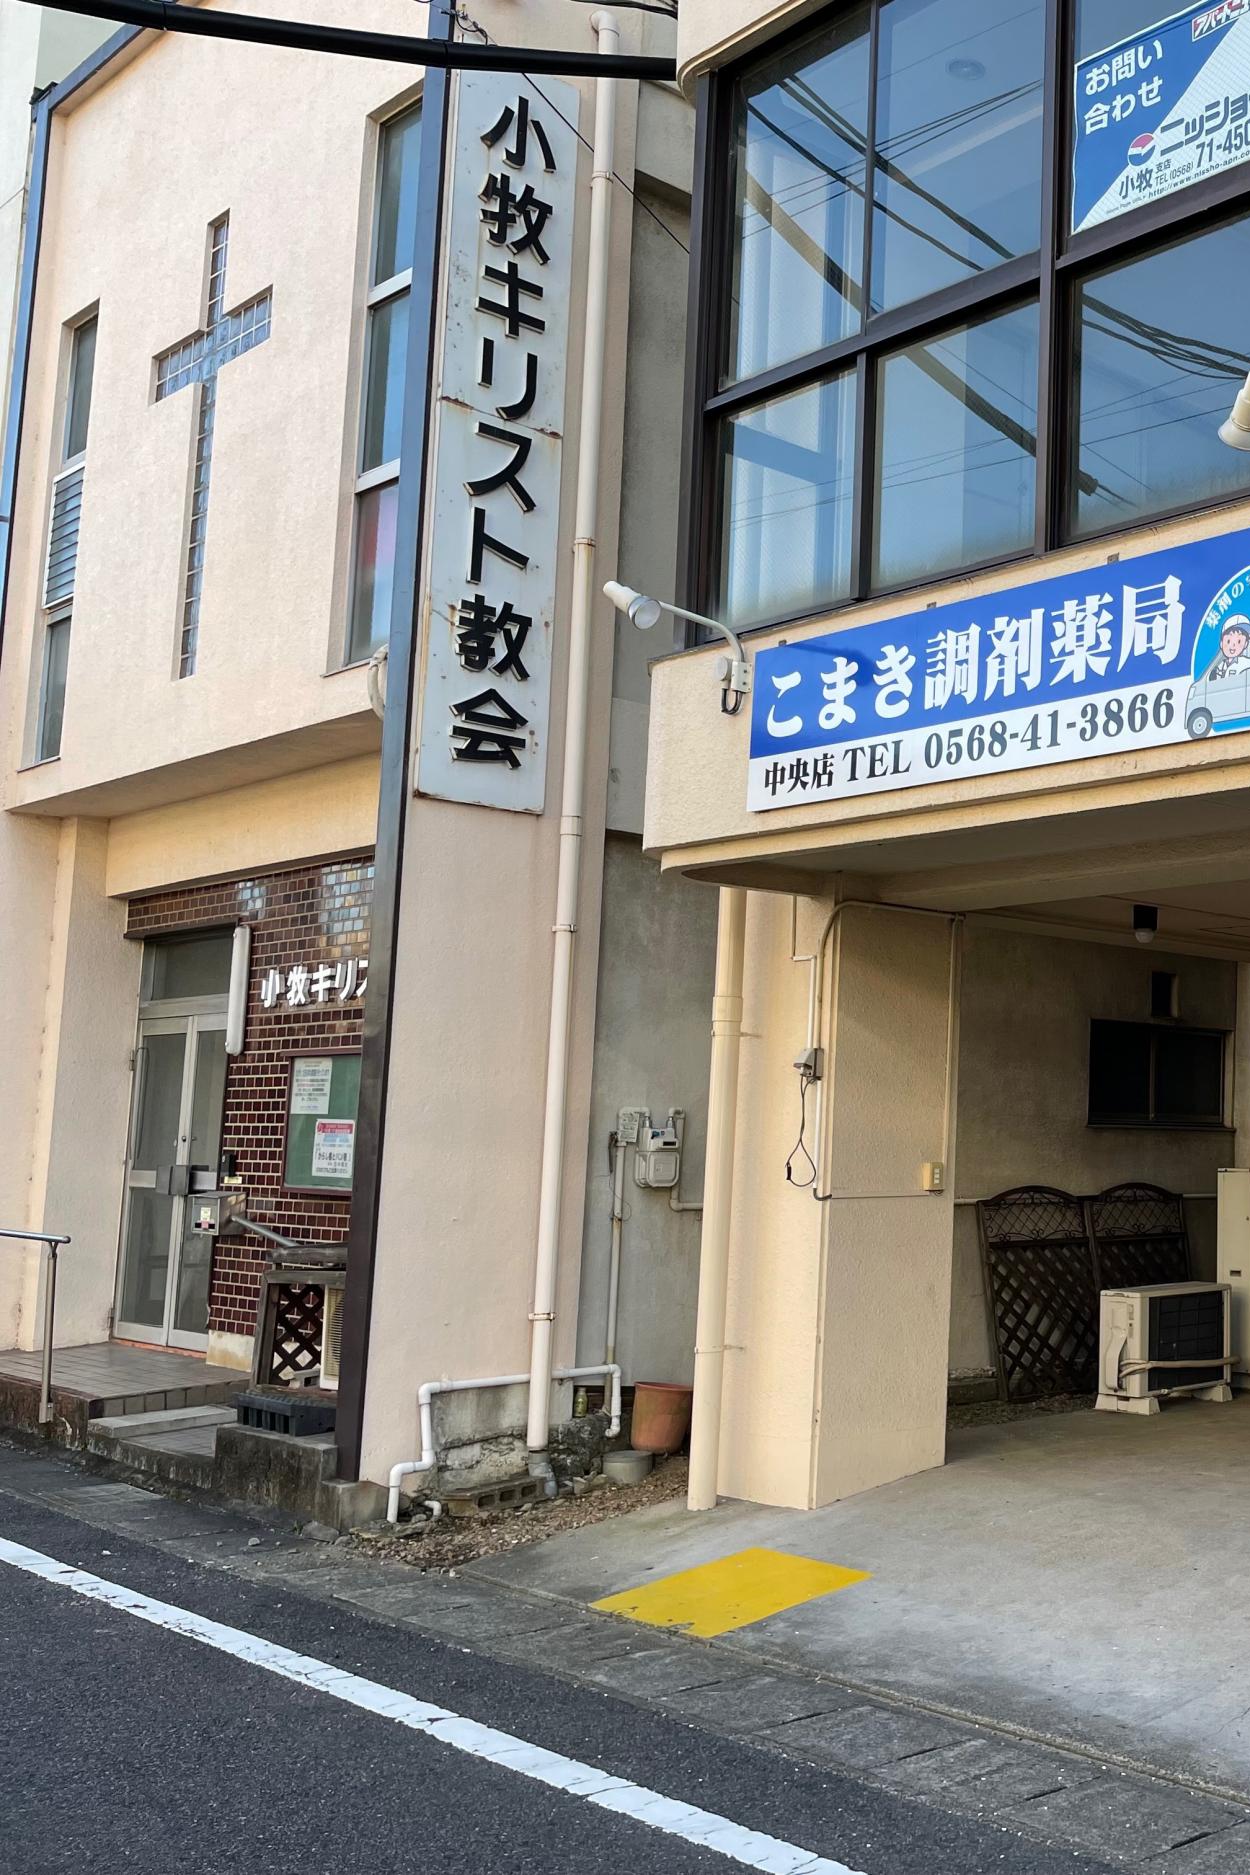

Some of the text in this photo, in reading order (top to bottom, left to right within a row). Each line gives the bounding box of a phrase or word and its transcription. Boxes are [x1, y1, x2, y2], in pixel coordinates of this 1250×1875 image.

[1084, 75, 1163, 135] 合わせ
[1085, 40, 1163, 96] お問い
[1119, 159, 1172, 200] 小牧 支店
[450, 96, 556, 770] 小牧キリスト教会
[766, 574, 1187, 738] こまき調剤薬局
[764, 687, 1175, 797] 中央店 TEL 0568-41-3866
